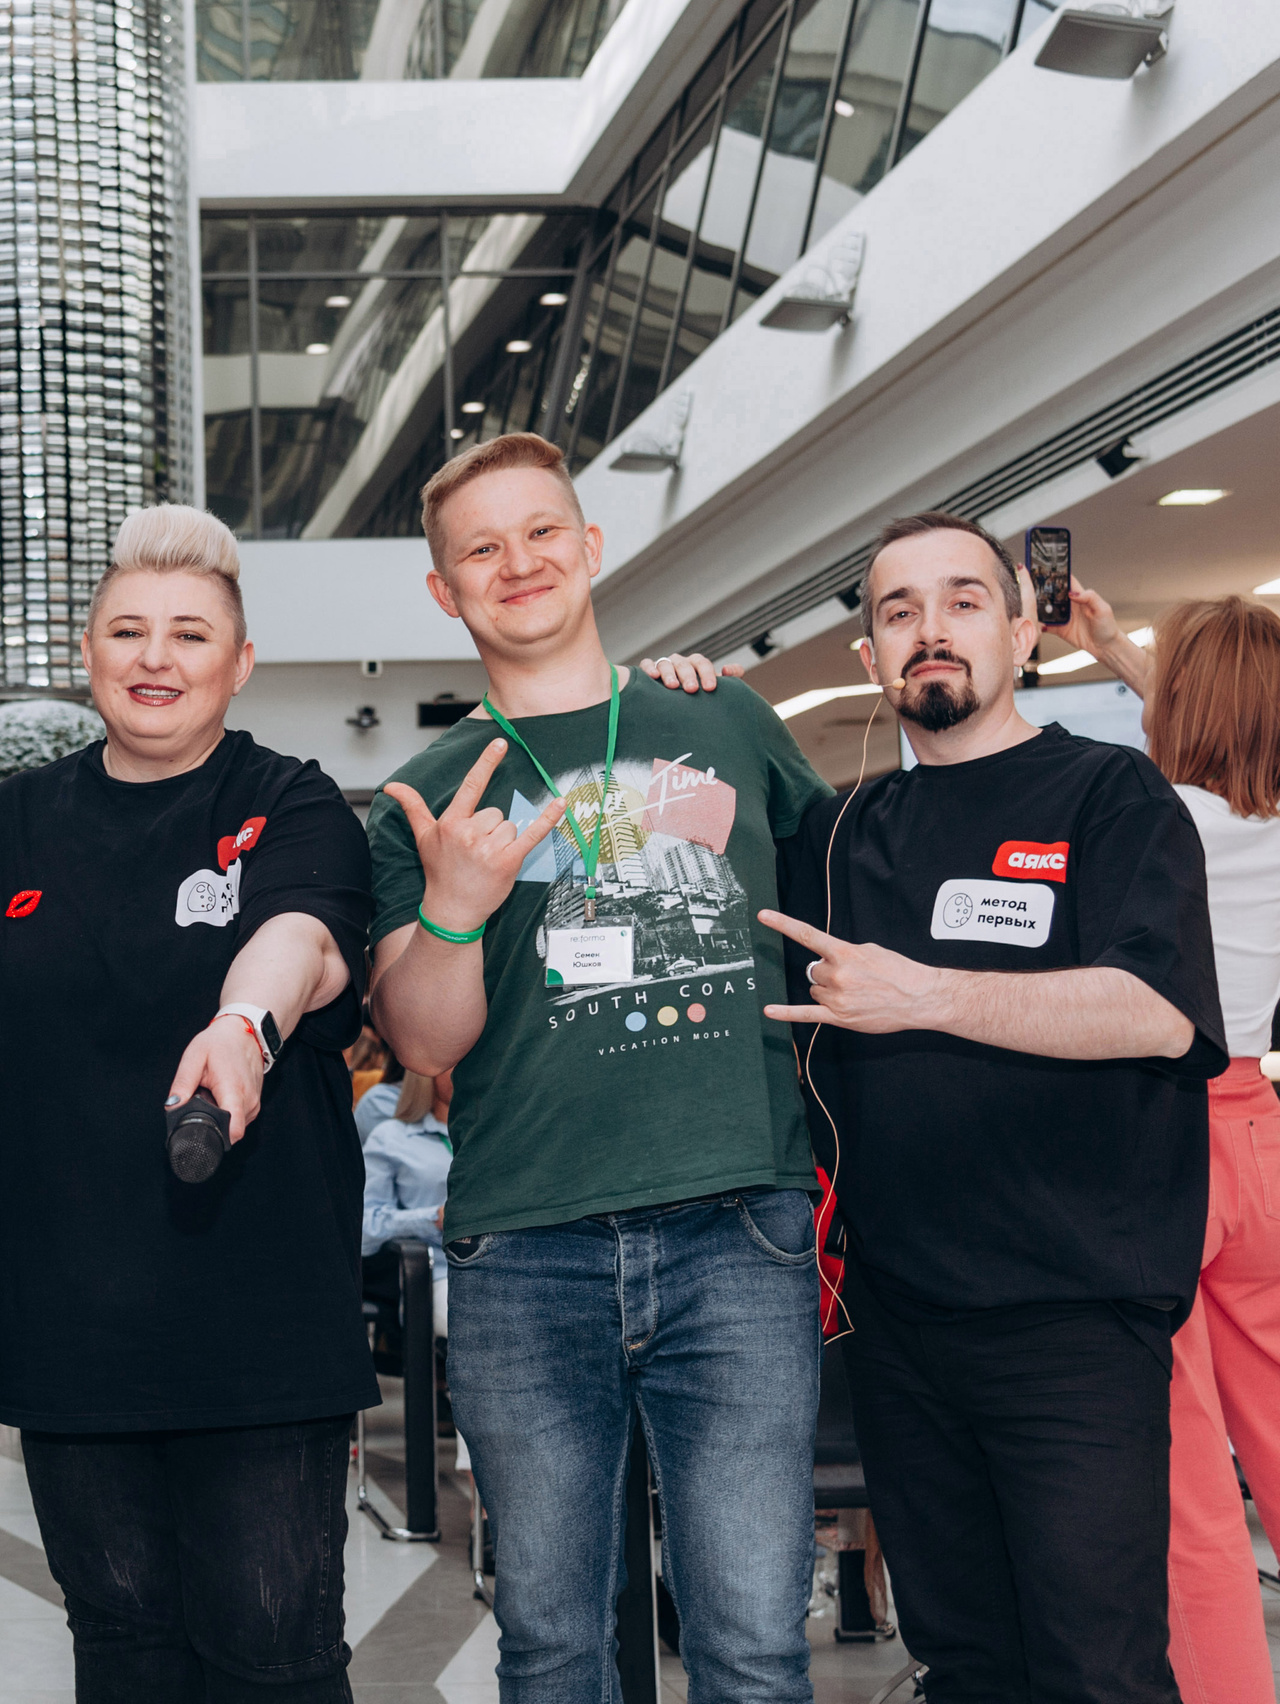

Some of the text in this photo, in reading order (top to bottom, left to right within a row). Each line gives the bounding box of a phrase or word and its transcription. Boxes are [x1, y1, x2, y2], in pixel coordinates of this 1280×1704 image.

[649, 752, 718, 816] Time
[1007, 851, 1066, 870] аякс
[980, 897, 1028, 912] метод
[977, 914, 1037, 930] первых
[572, 960, 602, 968] Юшков
[548, 977, 756, 1029] SOUTH COAS
[598, 1029, 730, 1056] VACATION MODE
